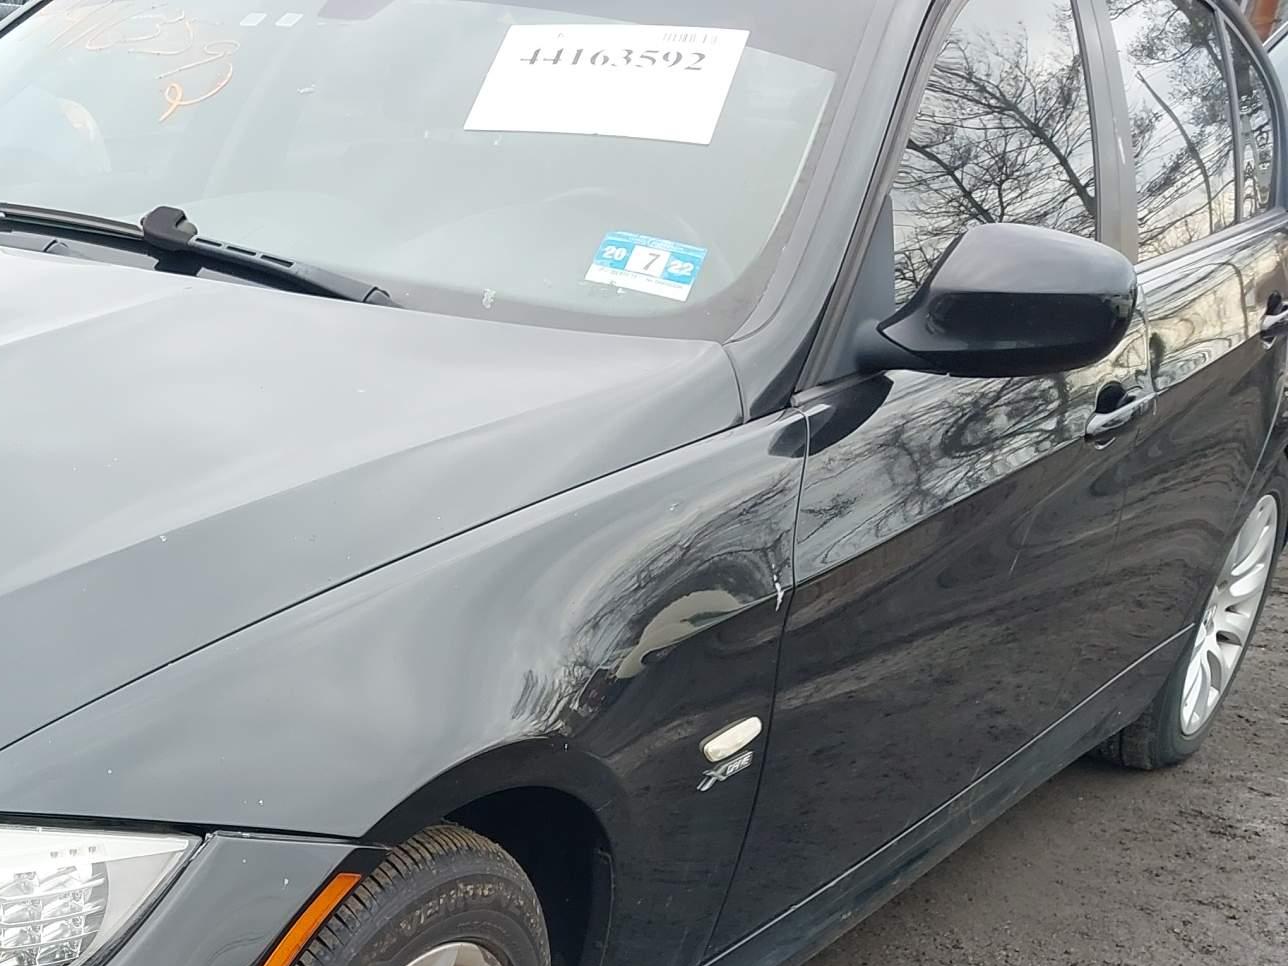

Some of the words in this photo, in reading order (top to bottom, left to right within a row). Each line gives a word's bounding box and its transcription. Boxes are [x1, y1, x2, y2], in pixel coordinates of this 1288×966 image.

[520, 47, 707, 71] 44163592
[602, 245, 628, 261] 20
[642, 252, 661, 271] 7
[667, 259, 695, 276] 22
